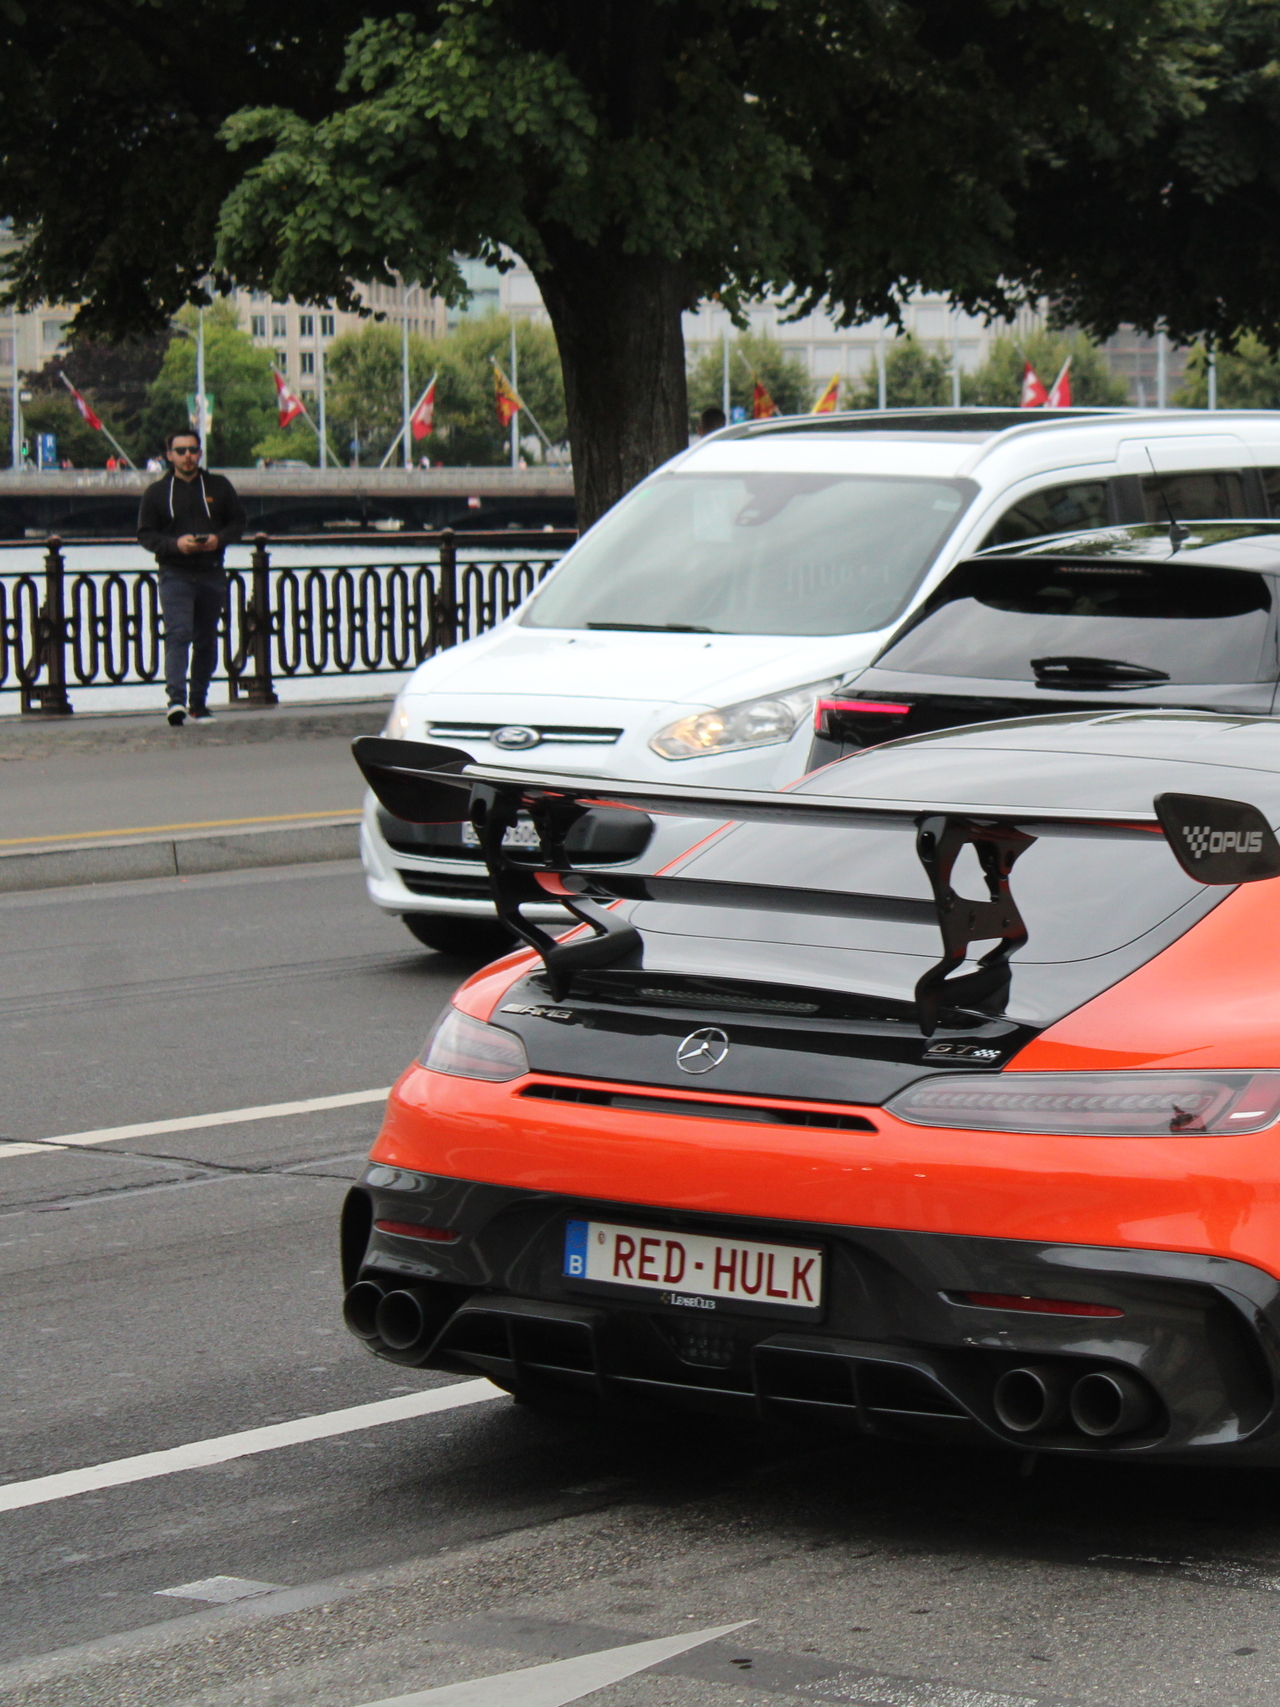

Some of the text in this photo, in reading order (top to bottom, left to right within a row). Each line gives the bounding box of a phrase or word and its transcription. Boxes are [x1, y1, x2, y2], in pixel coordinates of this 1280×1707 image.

[1209, 831, 1263, 853] OPUS
[520, 1005, 573, 1019] AMG
[928, 1043, 979, 1054] GT
[569, 1255, 582, 1274] B
